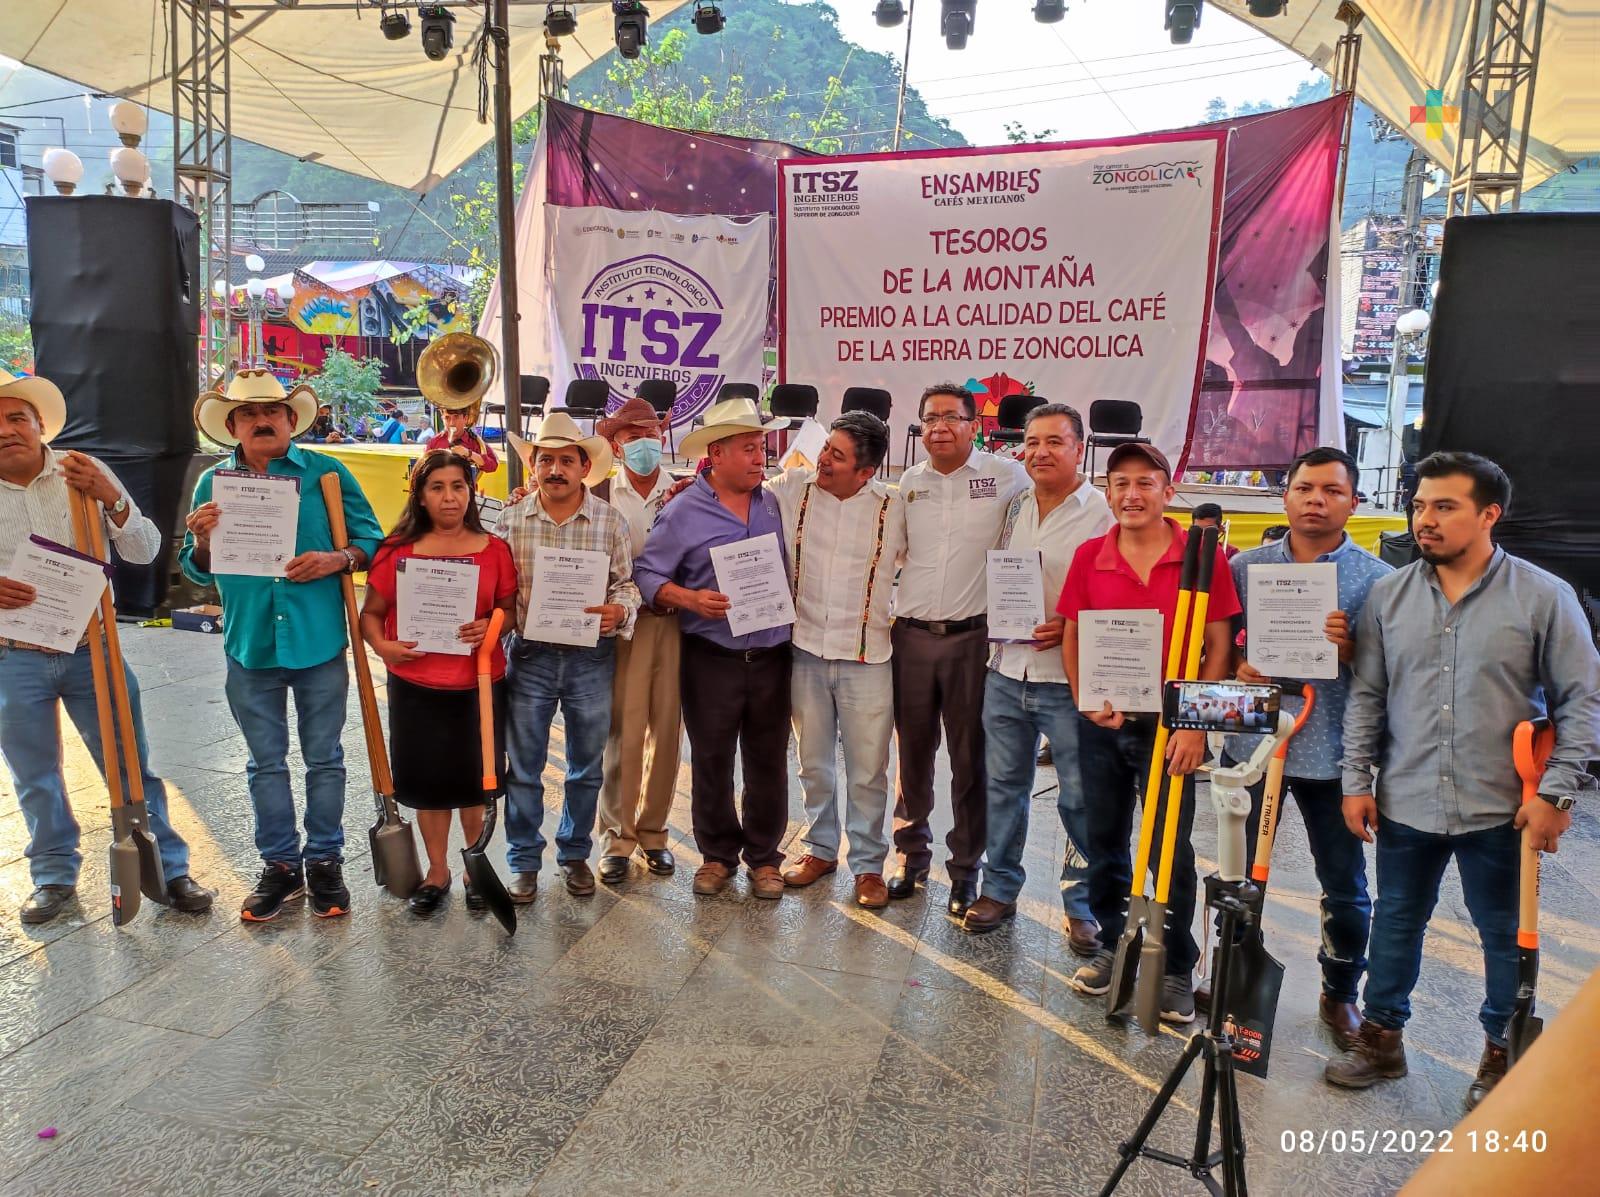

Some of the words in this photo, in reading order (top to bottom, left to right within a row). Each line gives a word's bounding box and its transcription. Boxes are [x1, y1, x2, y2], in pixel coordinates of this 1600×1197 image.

[793, 170, 858, 193] ITSZ
[921, 168, 1041, 199] ENSAMBLES
[1093, 168, 1184, 184] ZONGOLICA
[794, 193, 858, 203] INGENIEROS
[934, 195, 963, 207] CAFÉS
[966, 193, 1026, 206] MEXICANOS
[929, 227, 1048, 255] TESOROS
[594, 266, 643, 298] INSTITUTO
[643, 265, 708, 307] TECNOLÓGICO
[884, 268, 914, 295] DE
[923, 267, 952, 293] LA
[963, 255, 1095, 293] MONTAÑA
[299, 296, 352, 327] MUSIC
[821, 305, 897, 328] PREMIO
[902, 305, 918, 328] A
[924, 305, 951, 327] LA
[957, 302, 1053, 327] CALIDAD
[1059, 300, 1101, 324] DEL
[1108, 291, 1167, 323] CAFÉ
[581, 303, 722, 368] ITSZ
[838, 340, 865, 362] DE
[871, 340, 896, 362] LA
[903, 338, 973, 362] SIERRA
[979, 338, 1007, 361] DE
[1013, 334, 1144, 360] ZONGOLICA
[600, 362, 691, 383] INGENIEROS
[969, 478, 996, 489] ITSZ
[1262, 803, 1272, 836] TRUPER
